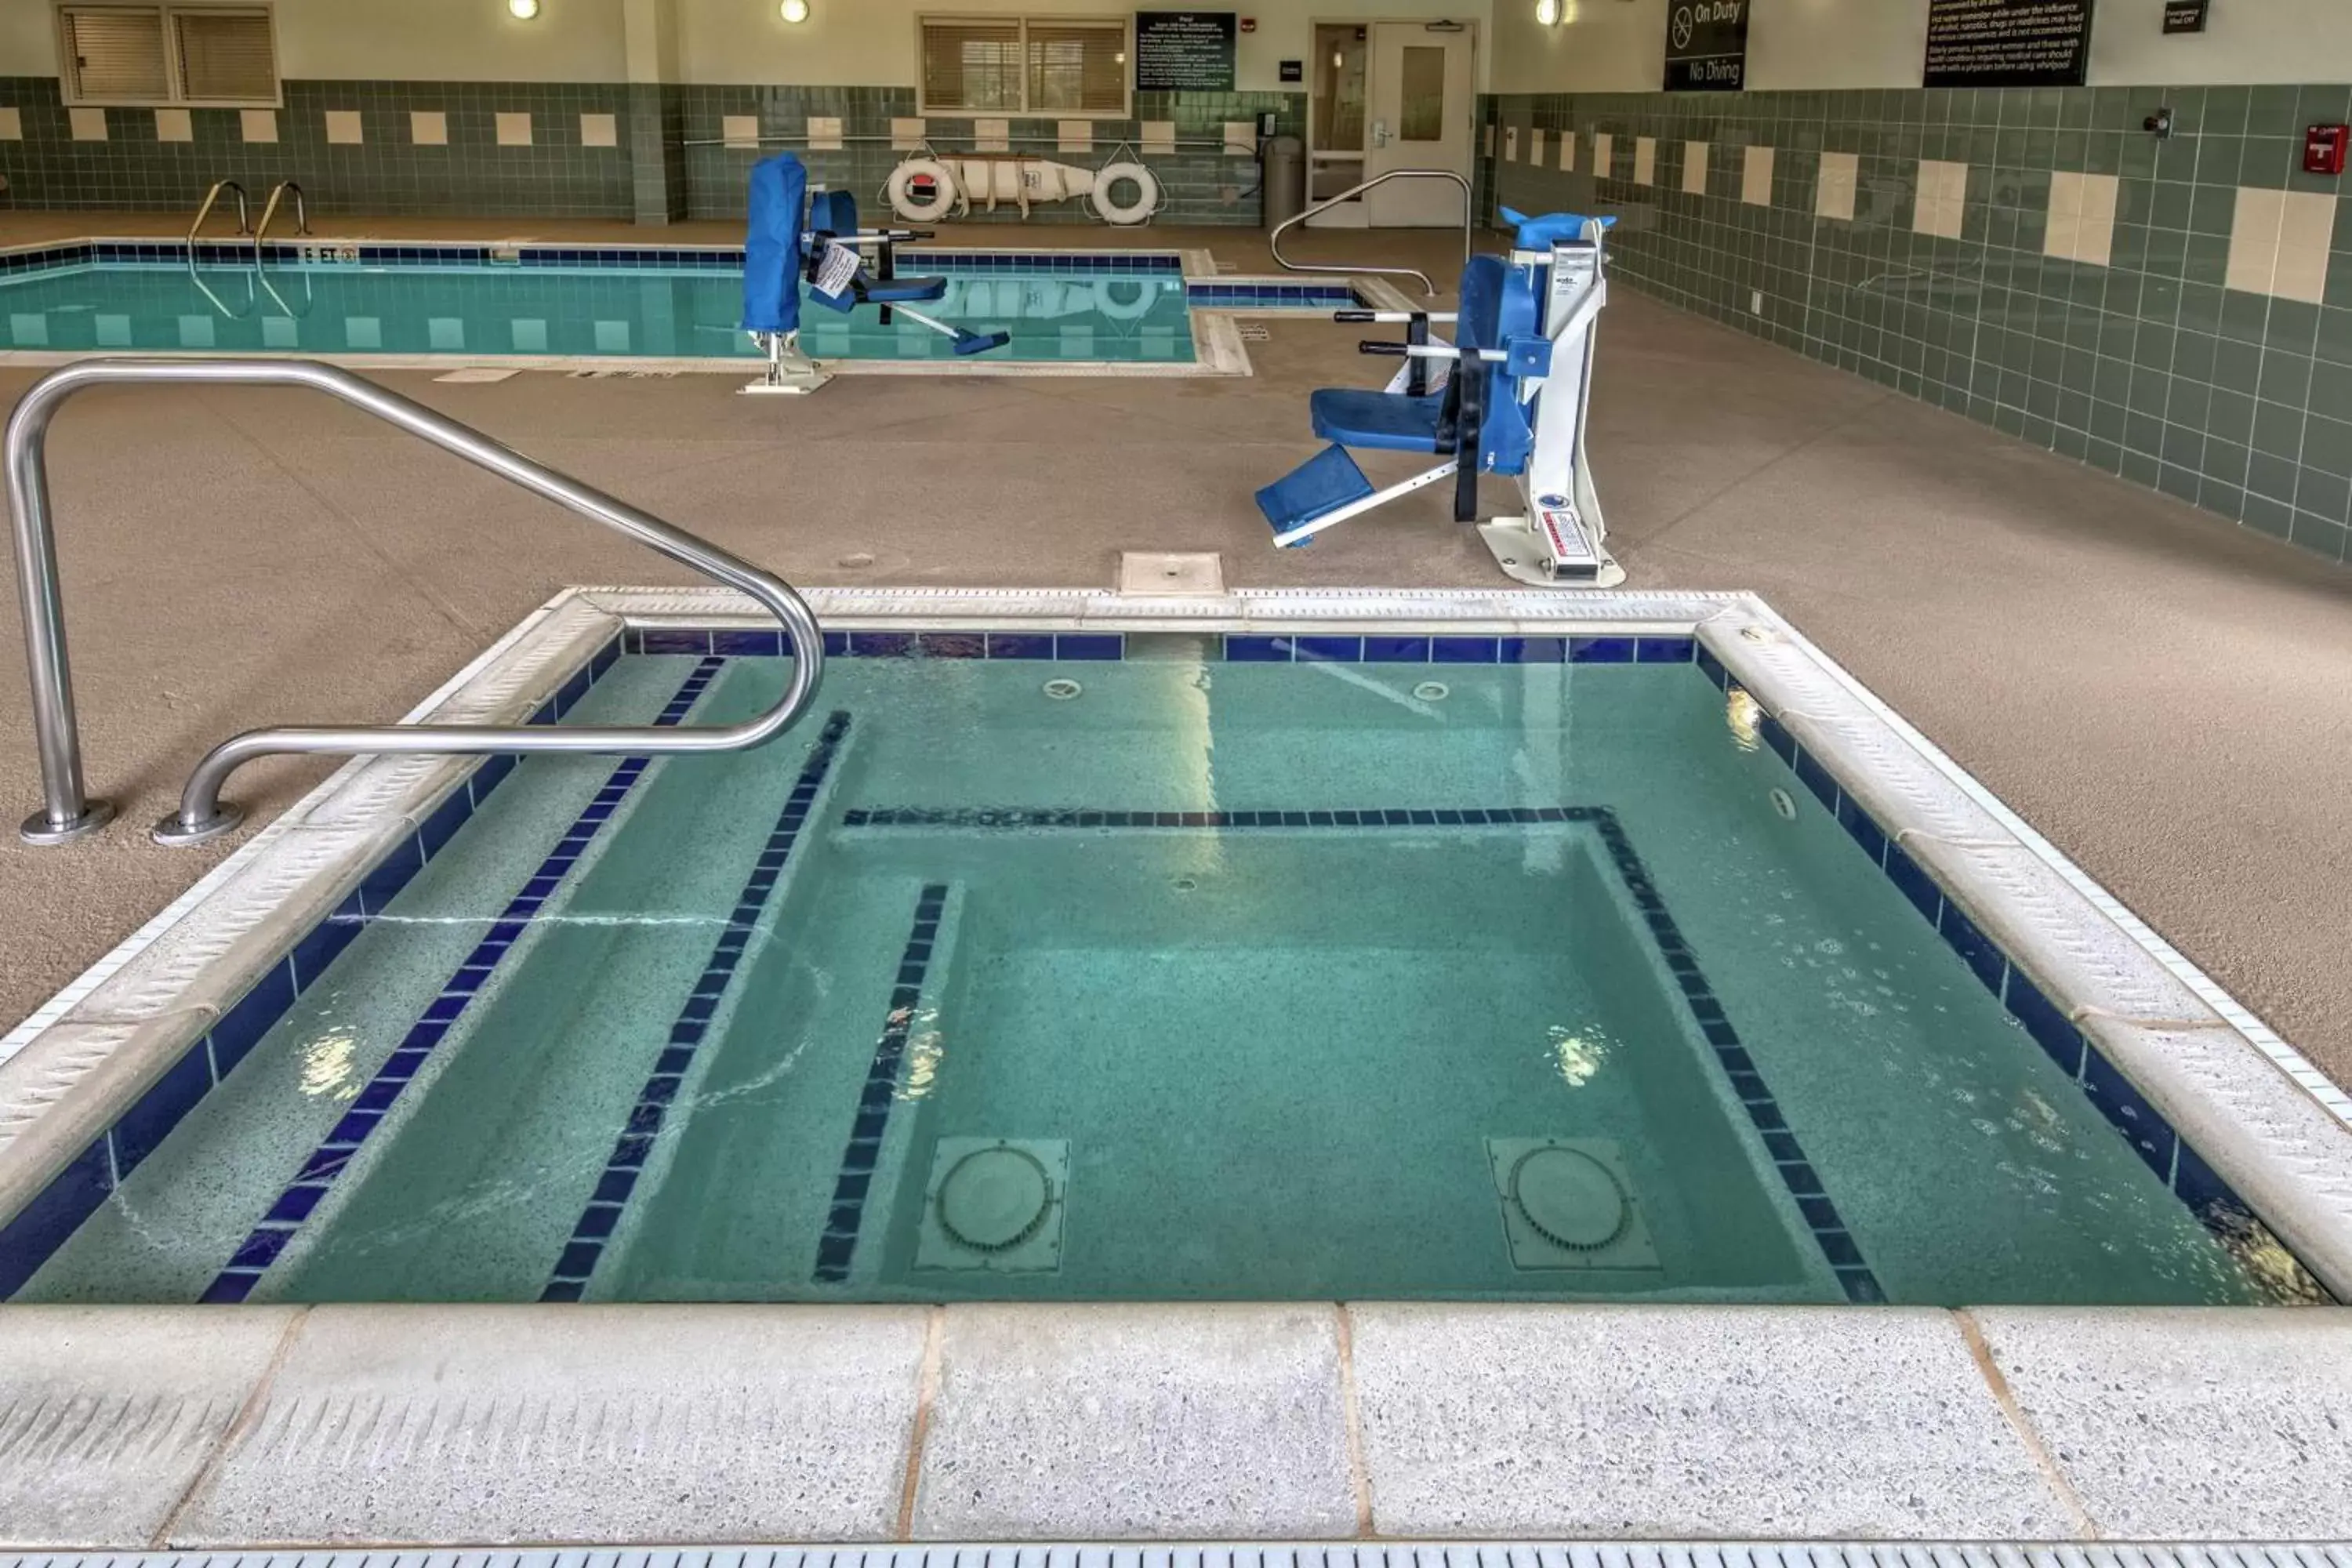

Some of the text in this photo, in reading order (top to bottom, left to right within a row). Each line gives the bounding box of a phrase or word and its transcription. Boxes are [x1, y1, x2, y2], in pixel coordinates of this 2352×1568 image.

[1694, 1, 1740, 24] On Duty
[2031, 5, 2044, 14] the
[2018, 27, 2031, 36] not
[1690, 59, 1740, 85] No Diving
